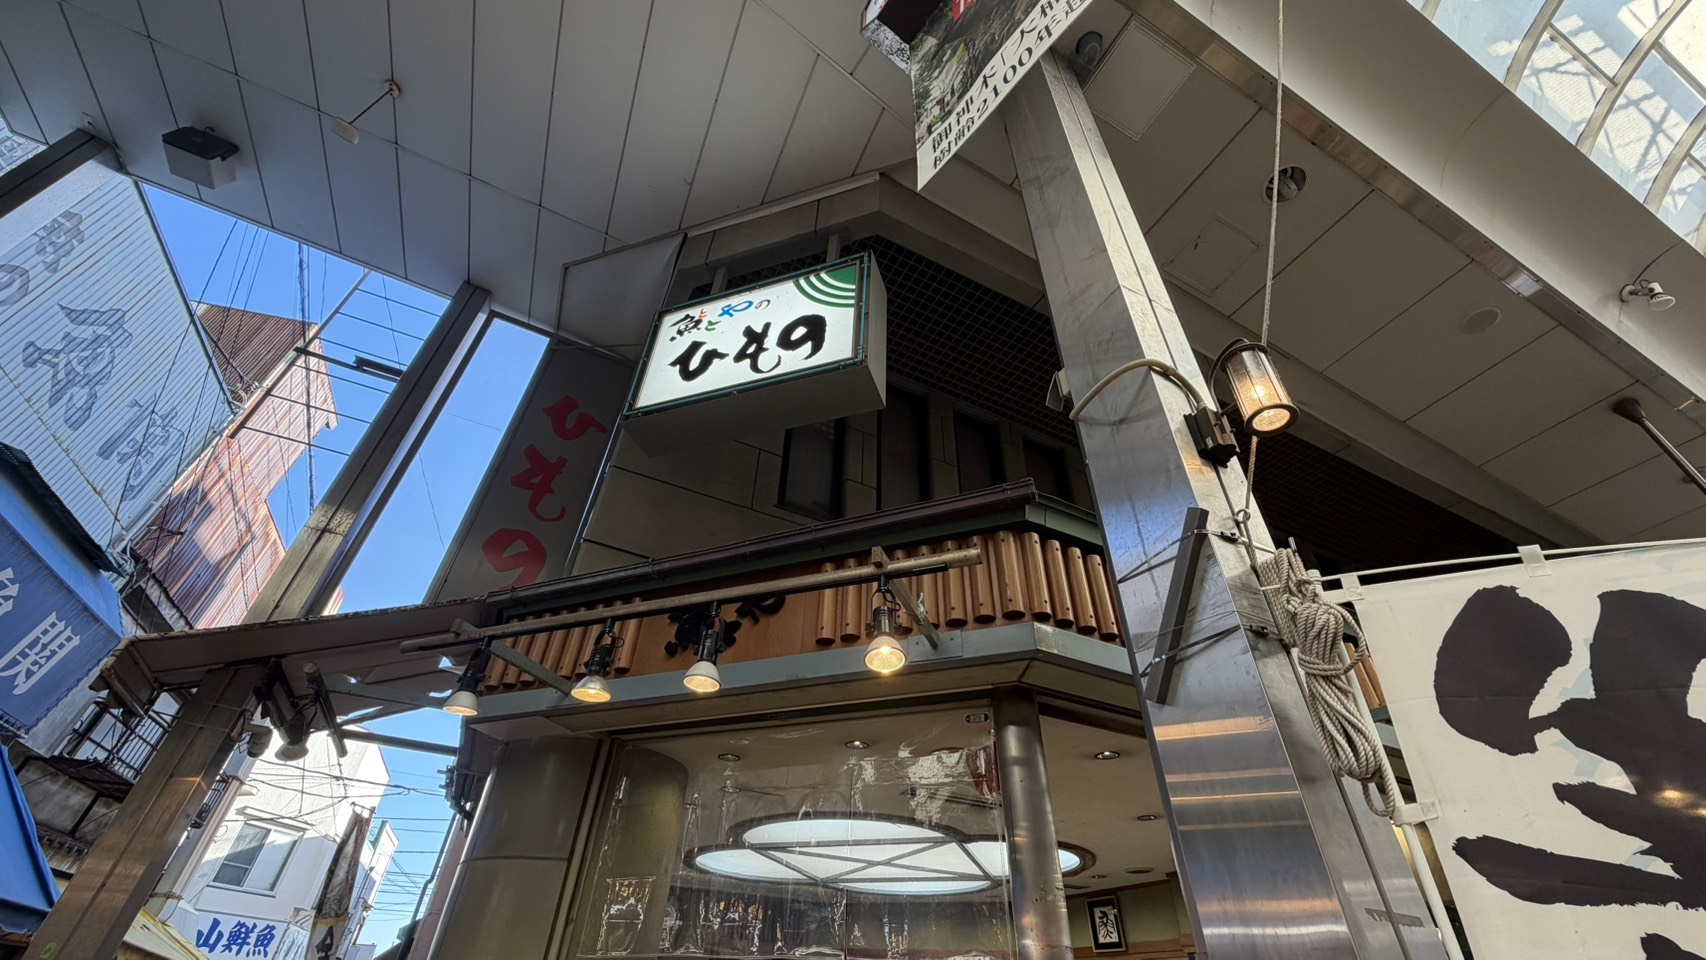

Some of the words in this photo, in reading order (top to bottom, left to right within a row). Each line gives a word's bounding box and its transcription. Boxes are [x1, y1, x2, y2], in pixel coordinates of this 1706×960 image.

[668, 314, 827, 382] ひもの
[481, 394, 608, 588] ひもの
[196, 917, 276, 958] 山鮮魚
